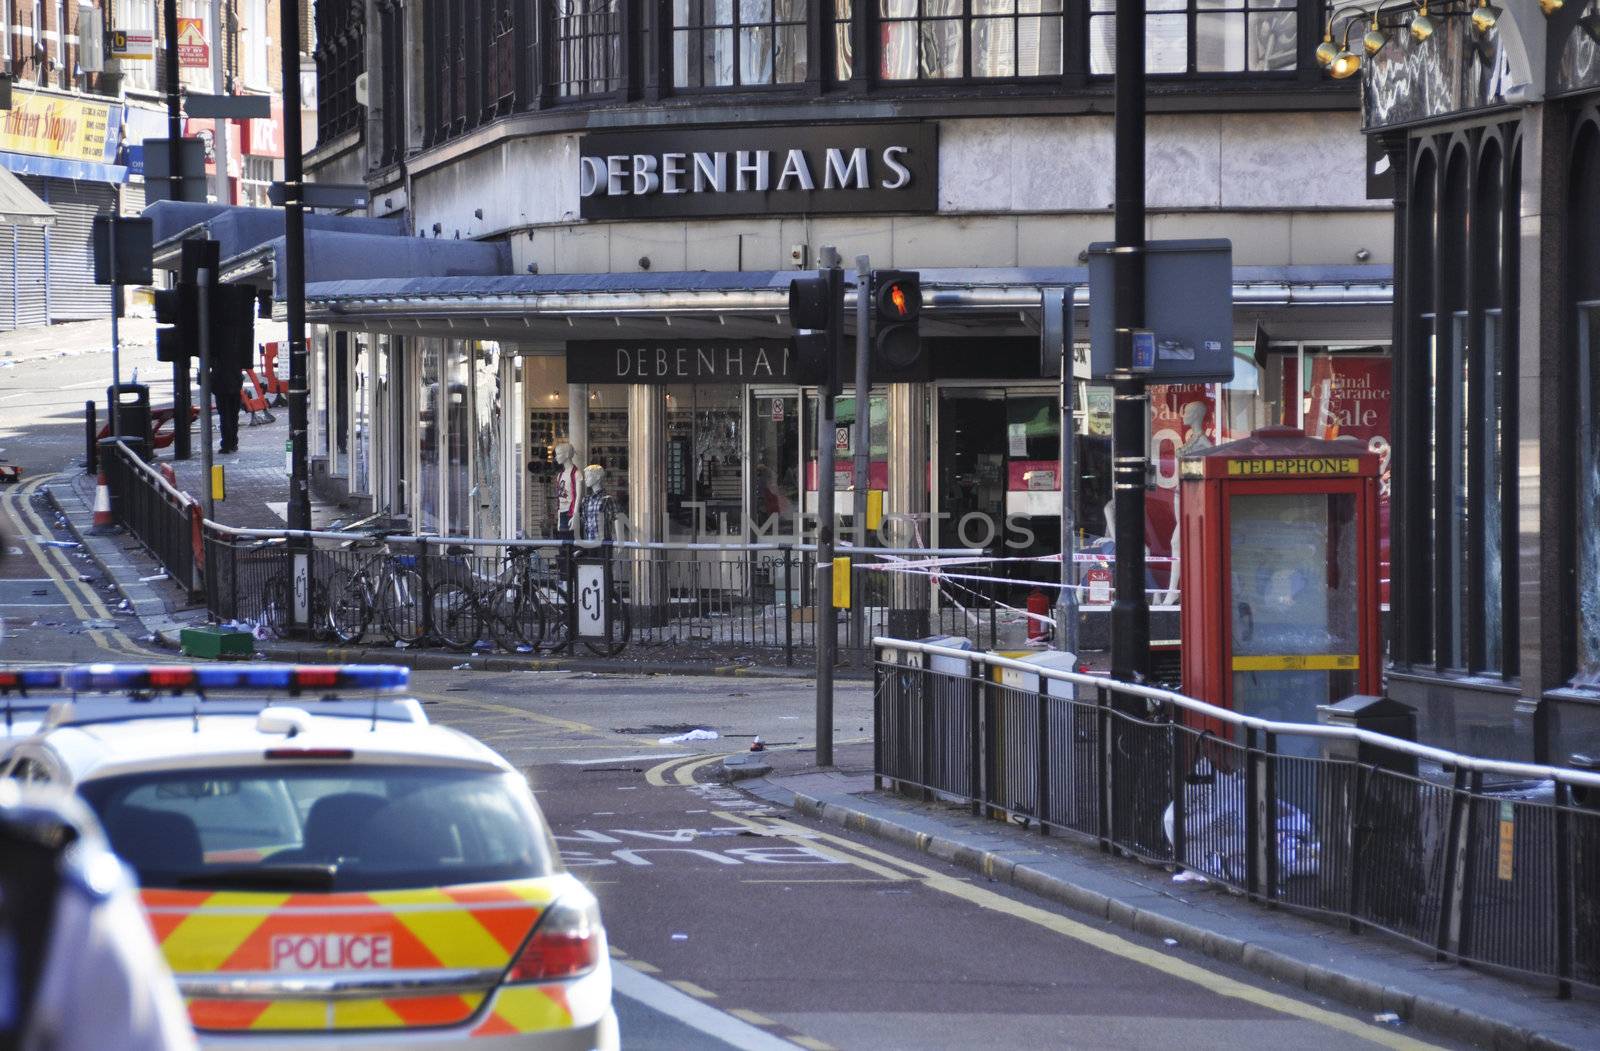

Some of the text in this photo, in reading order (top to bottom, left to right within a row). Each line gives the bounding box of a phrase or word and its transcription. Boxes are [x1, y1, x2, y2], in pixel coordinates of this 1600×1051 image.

[42, 102, 77, 151] Shoppe
[253, 118, 278, 150] KFC
[580, 146, 911, 199] DEBENHAMS
[616, 348, 790, 377] DEBENHA
[1331, 373, 1371, 388] Final
[1319, 400, 1378, 427] Sale
[1236, 459, 1351, 475] TELEPHONE
[1091, 571, 1108, 580] Sale
[272, 936, 390, 970] POLICE
